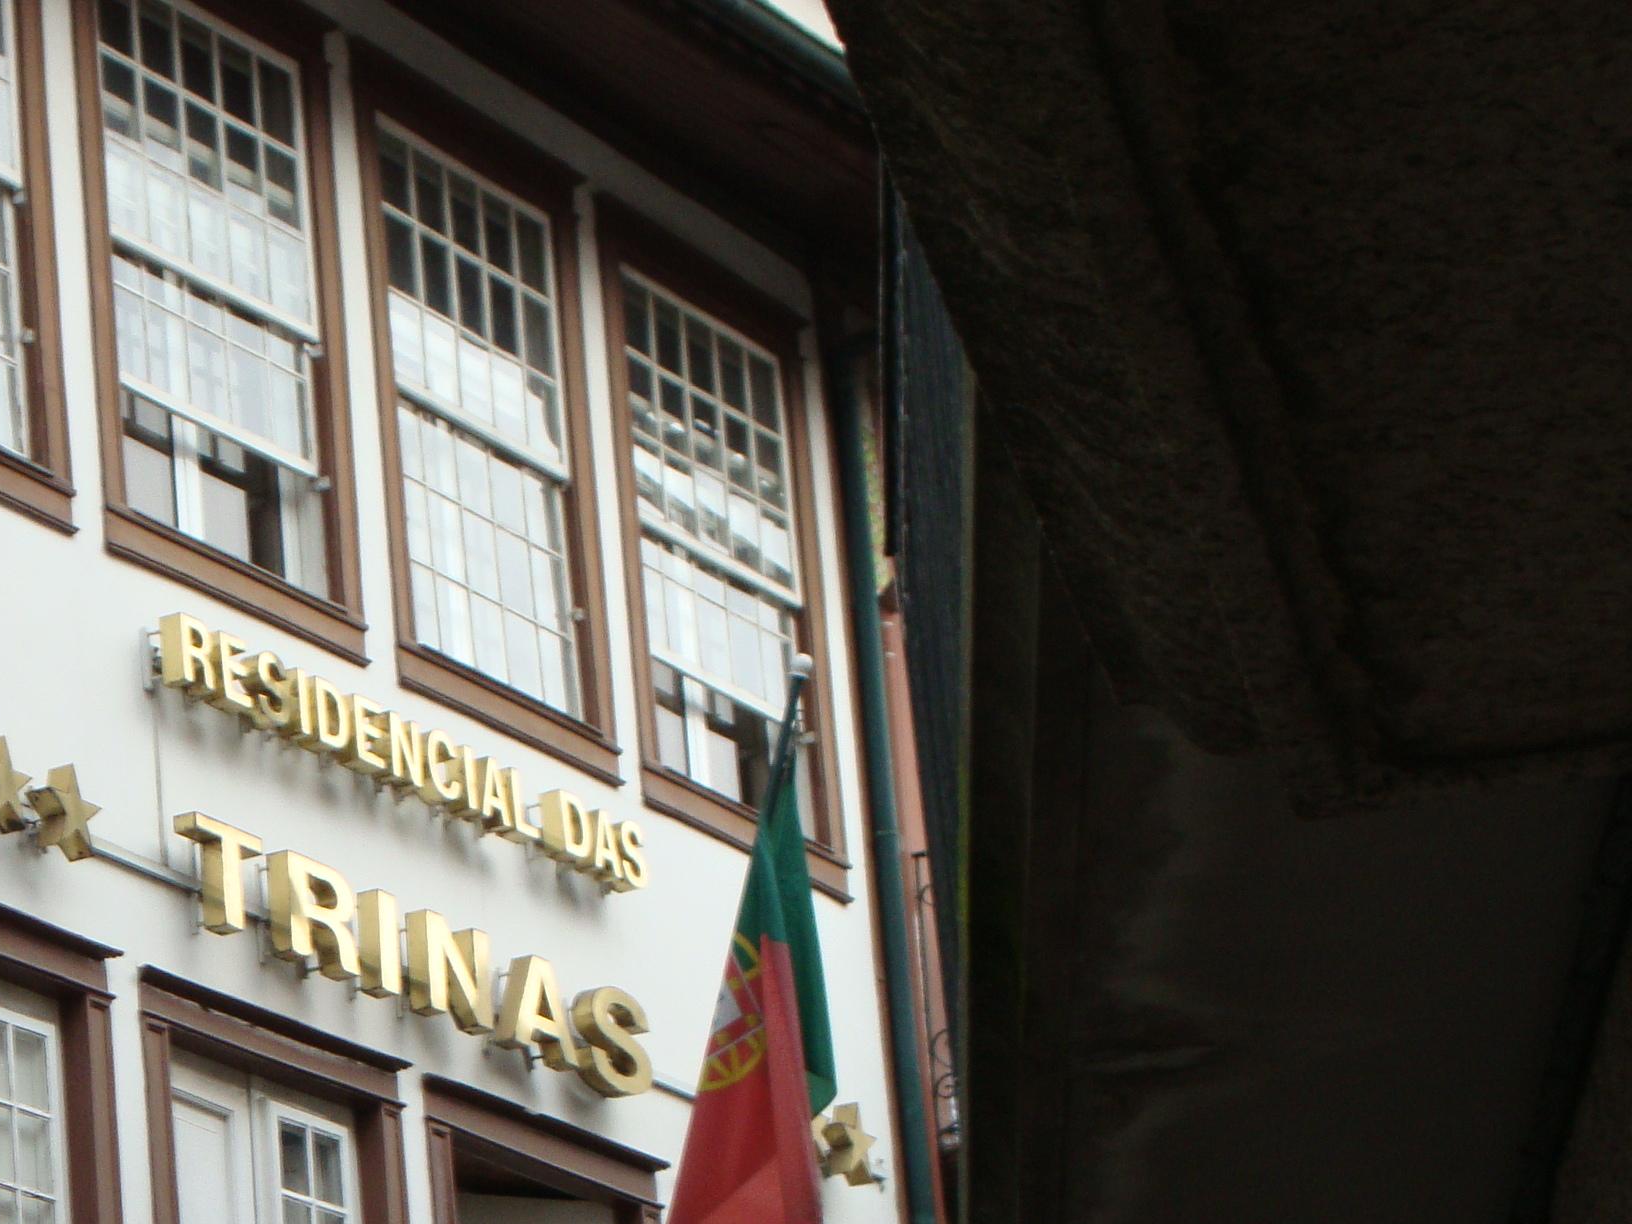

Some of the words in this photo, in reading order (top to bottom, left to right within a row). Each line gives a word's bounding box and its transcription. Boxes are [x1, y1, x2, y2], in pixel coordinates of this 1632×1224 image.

[158, 612, 541, 843] RESIDENCIAL
[538, 789, 648, 893] DAS
[173, 811, 655, 1098] TRINAS
